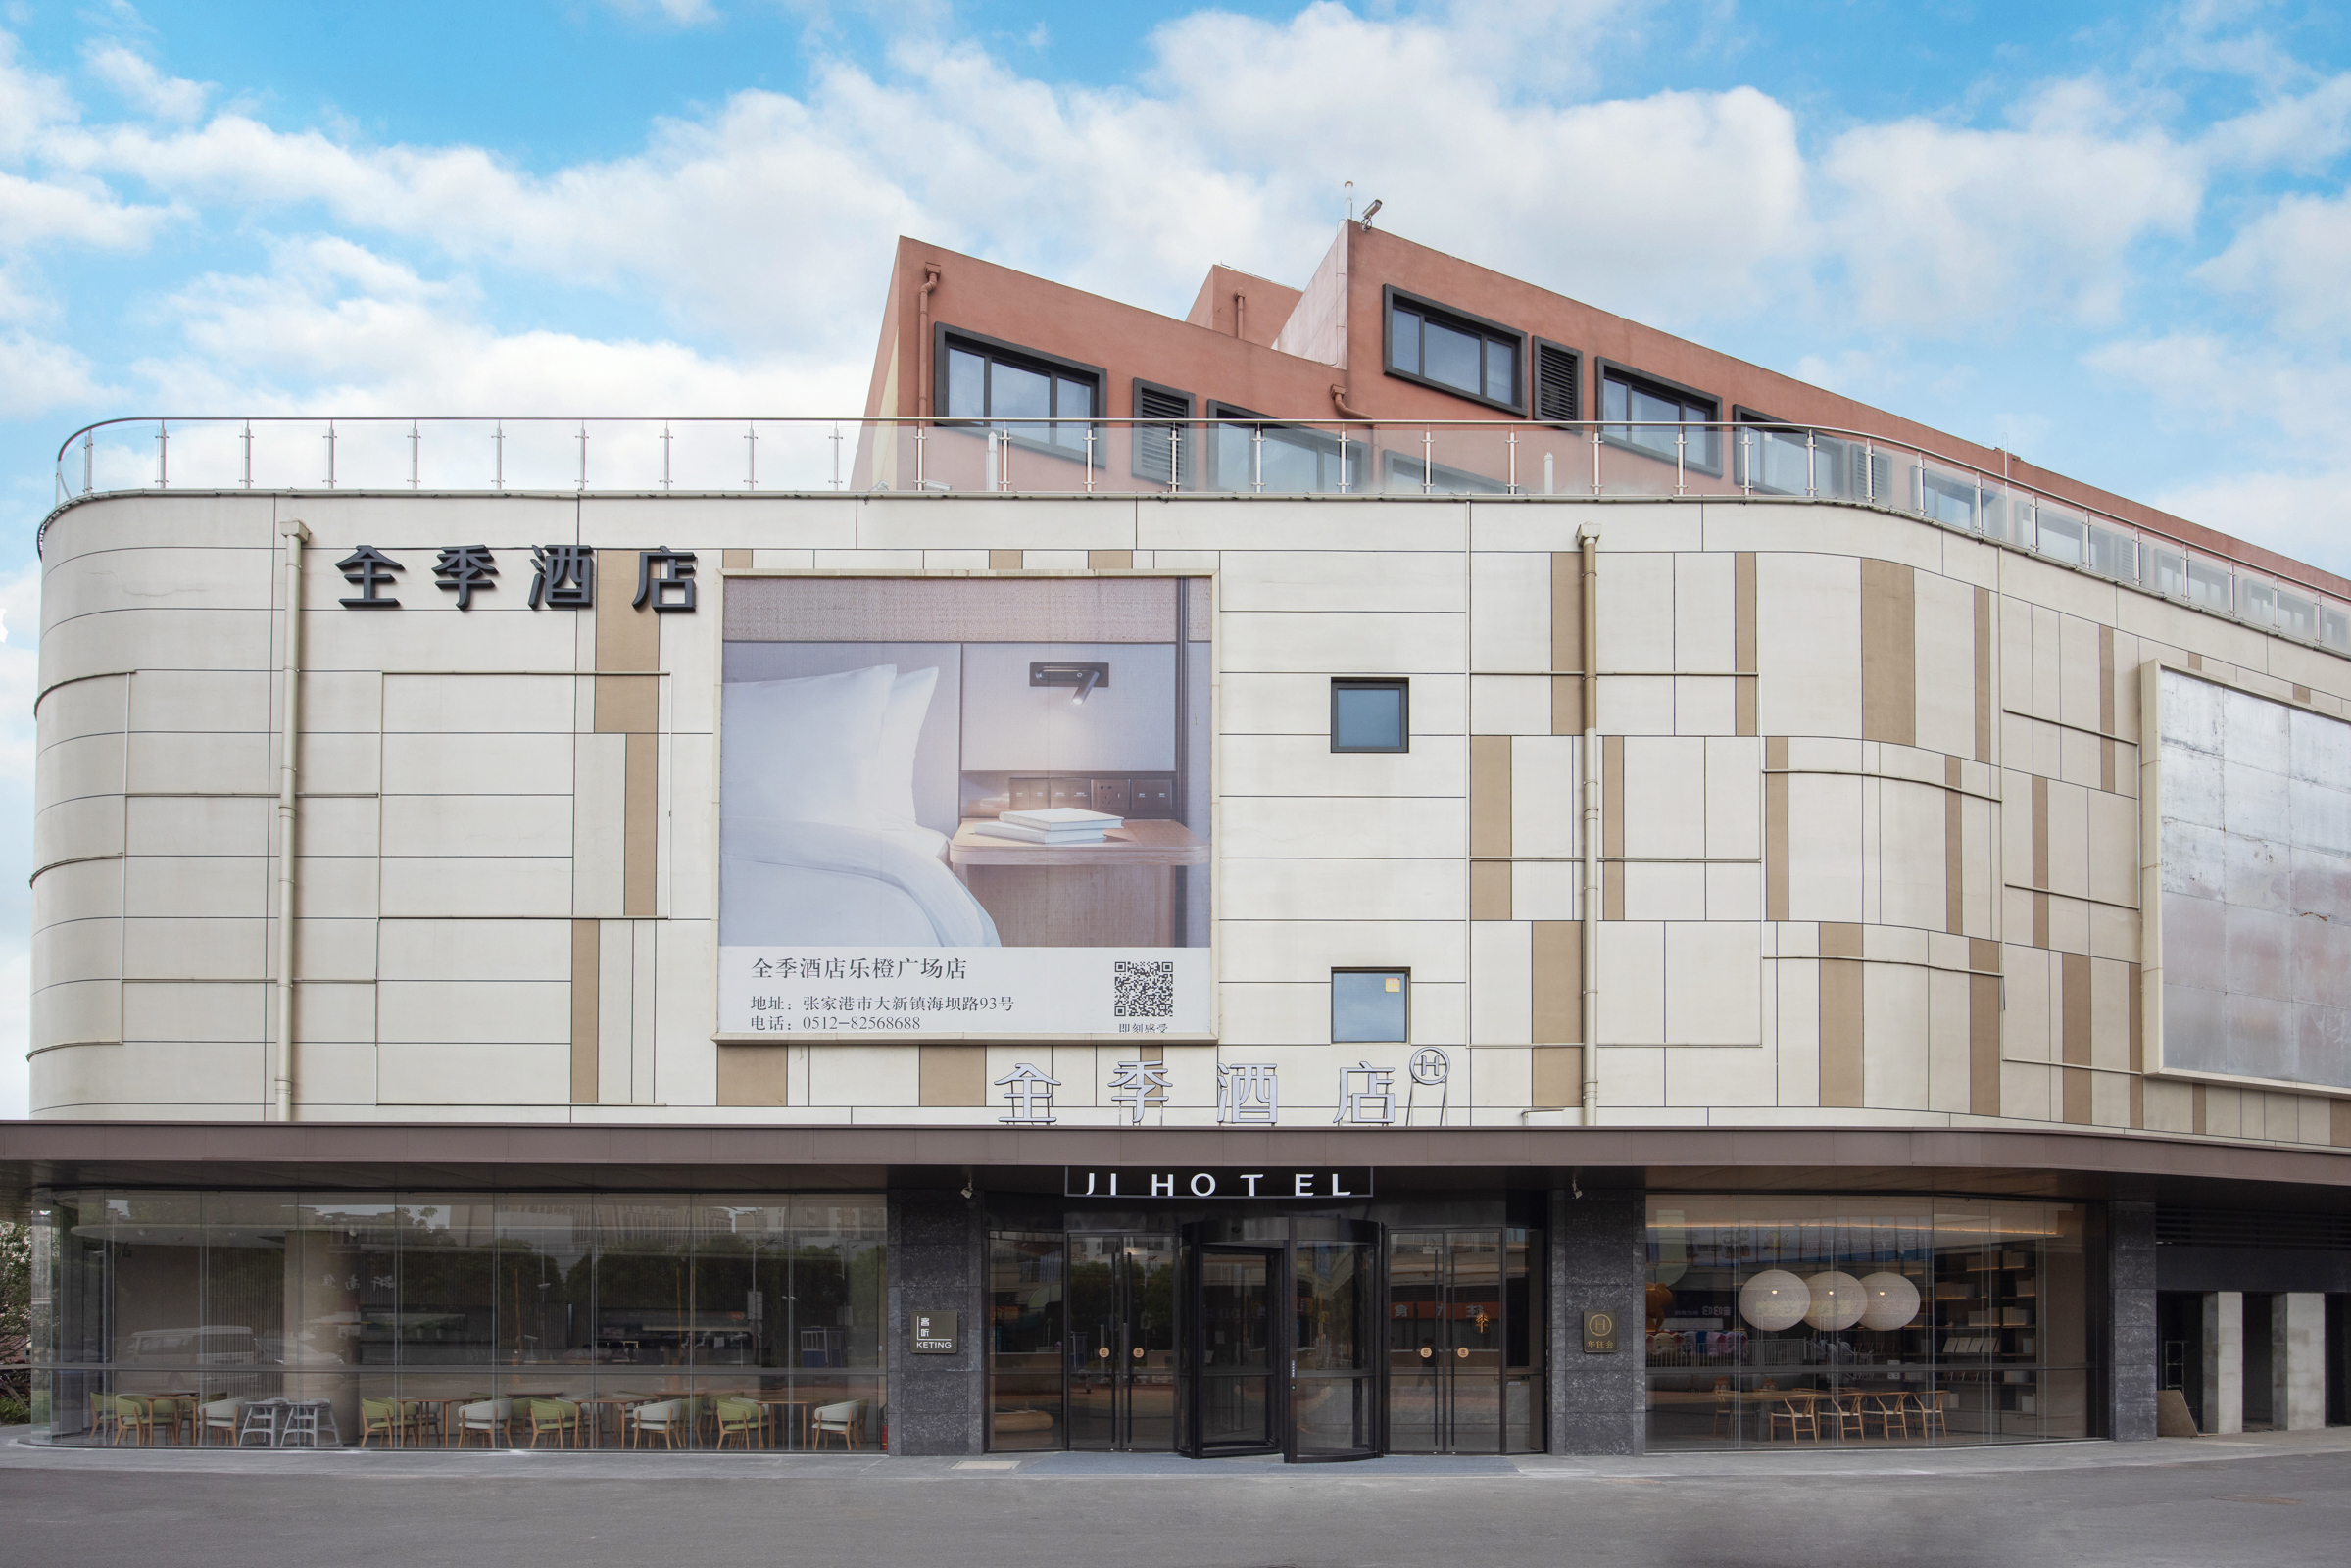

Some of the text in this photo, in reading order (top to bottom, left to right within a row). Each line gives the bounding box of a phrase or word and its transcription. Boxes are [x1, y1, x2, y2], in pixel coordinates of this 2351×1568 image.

[334, 544, 697, 612] 全季酒店
[751, 957, 967, 979] 全季酒店乐橙广场店
[993, 1059, 1396, 1125] 全季酒店
[1085, 1172, 1351, 1197] JI HOTEL
[1587, 1340, 1614, 1349] 华住会
